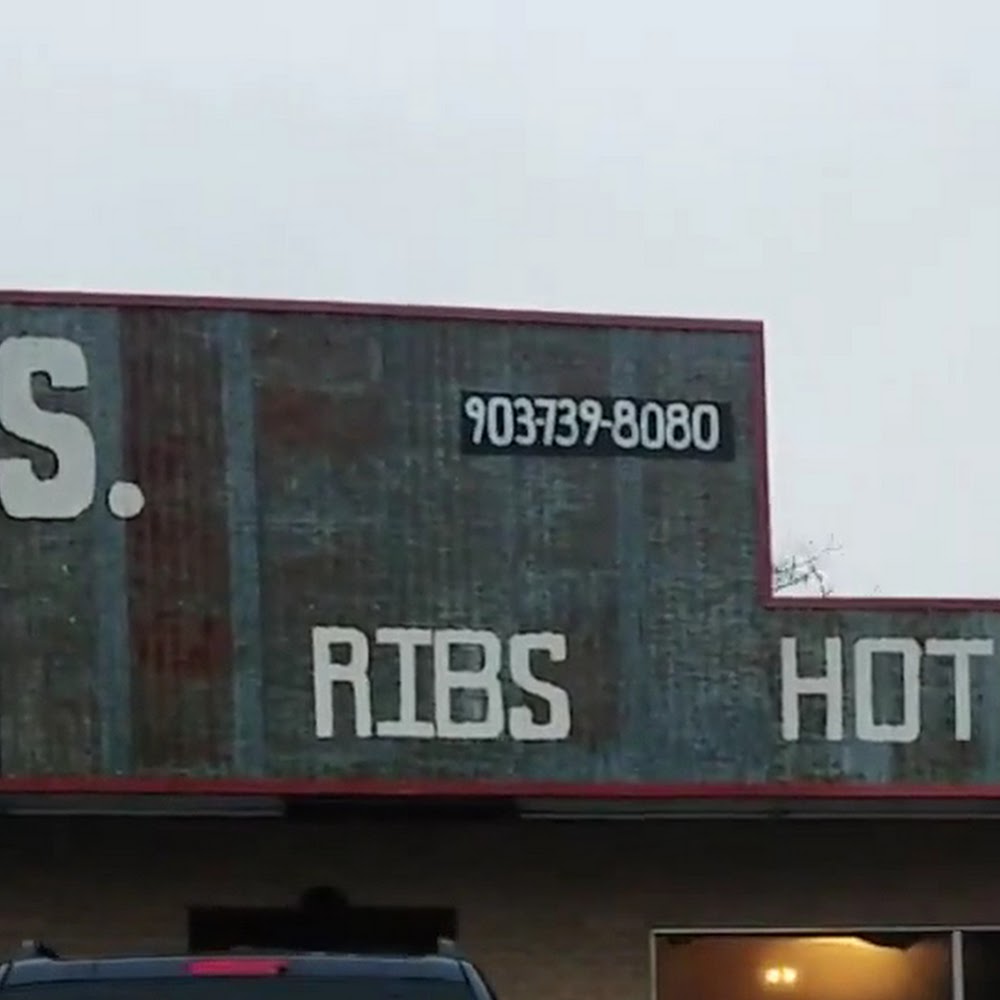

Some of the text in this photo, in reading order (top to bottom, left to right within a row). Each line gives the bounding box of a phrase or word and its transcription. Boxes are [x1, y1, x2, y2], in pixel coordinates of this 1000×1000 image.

[465, 396, 719, 450] 903-739-8080
[311, 626, 570, 742] RIBS
[780, 636, 994, 743] HOT
